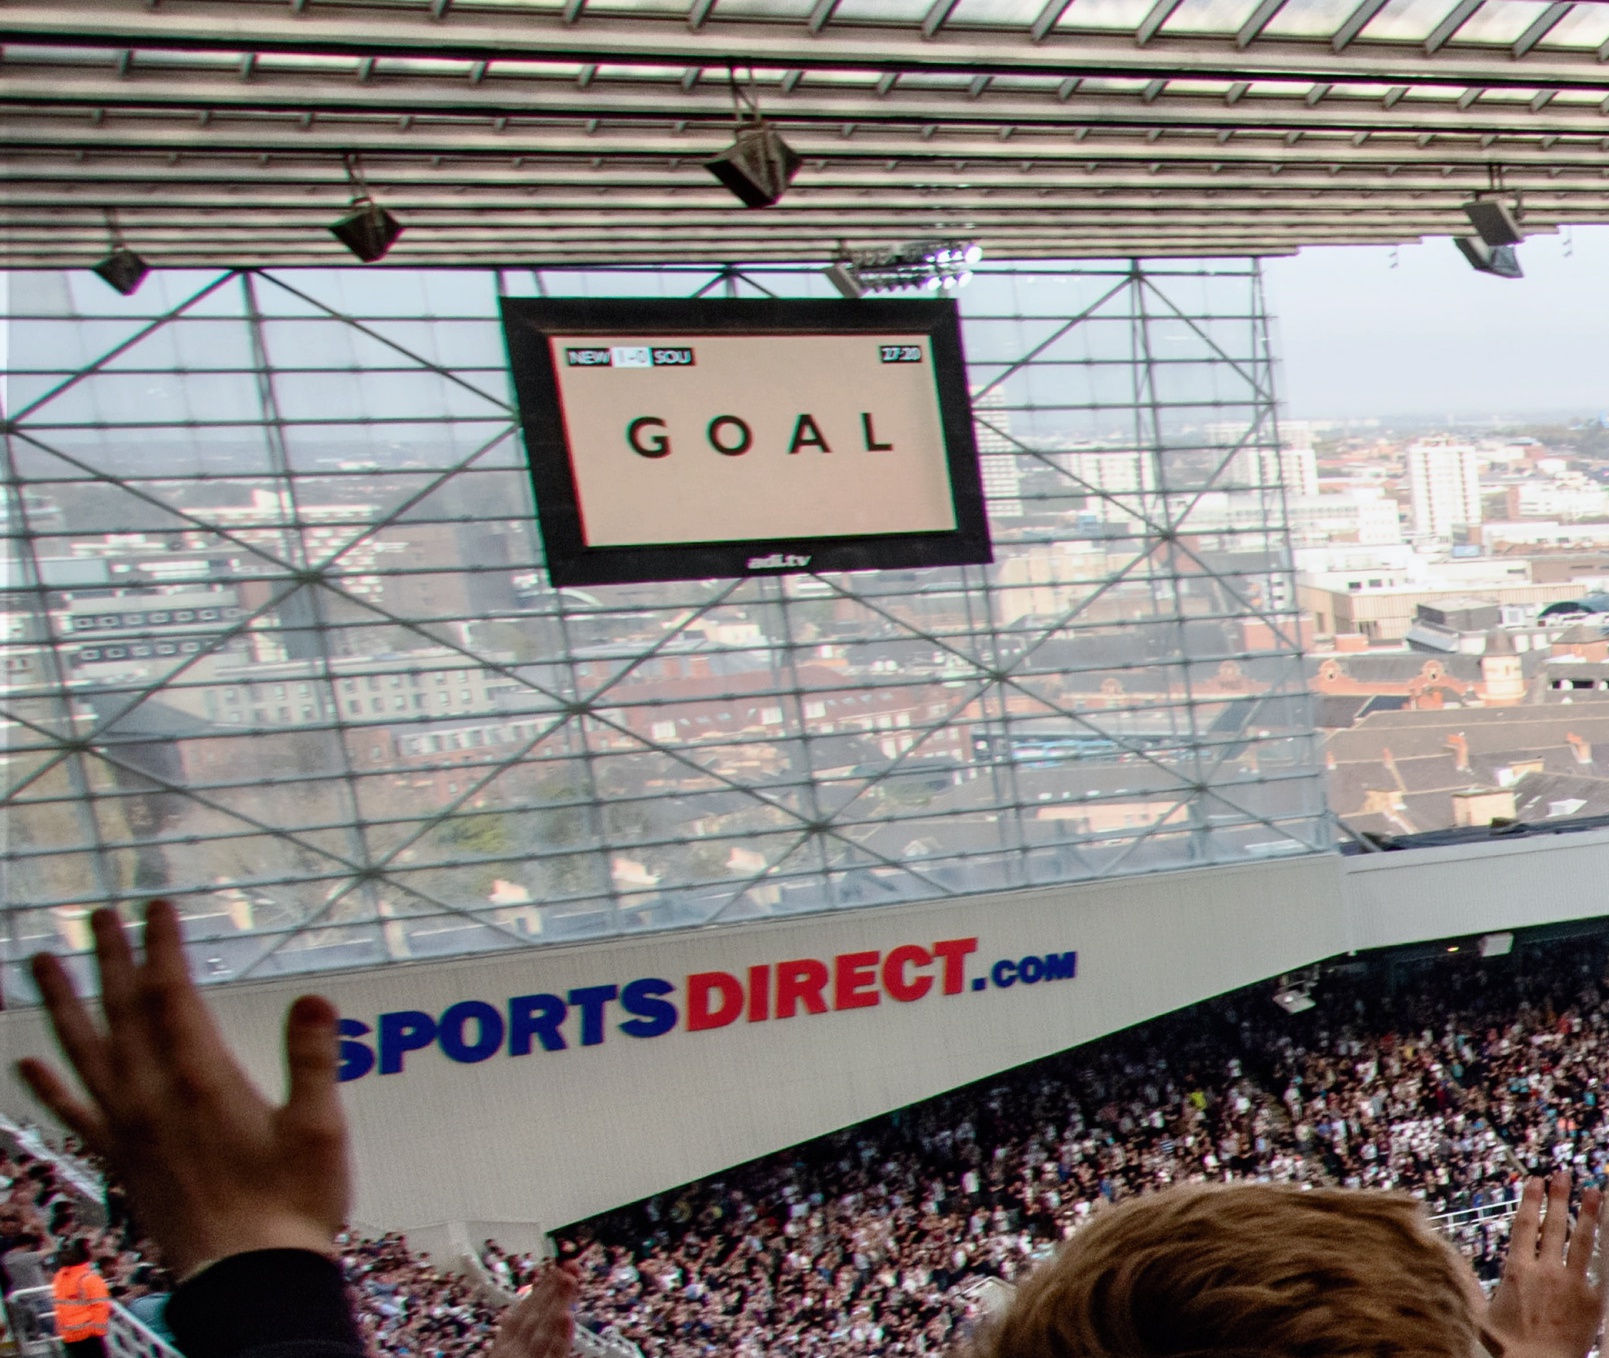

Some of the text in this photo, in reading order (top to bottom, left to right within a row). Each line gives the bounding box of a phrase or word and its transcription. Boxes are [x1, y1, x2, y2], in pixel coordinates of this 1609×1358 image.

[567, 350, 610, 365] NEW
[653, 349, 692, 364] SOU
[626, 412, 895, 459] GOAL
[746, 553, 812, 571] adi.tv
